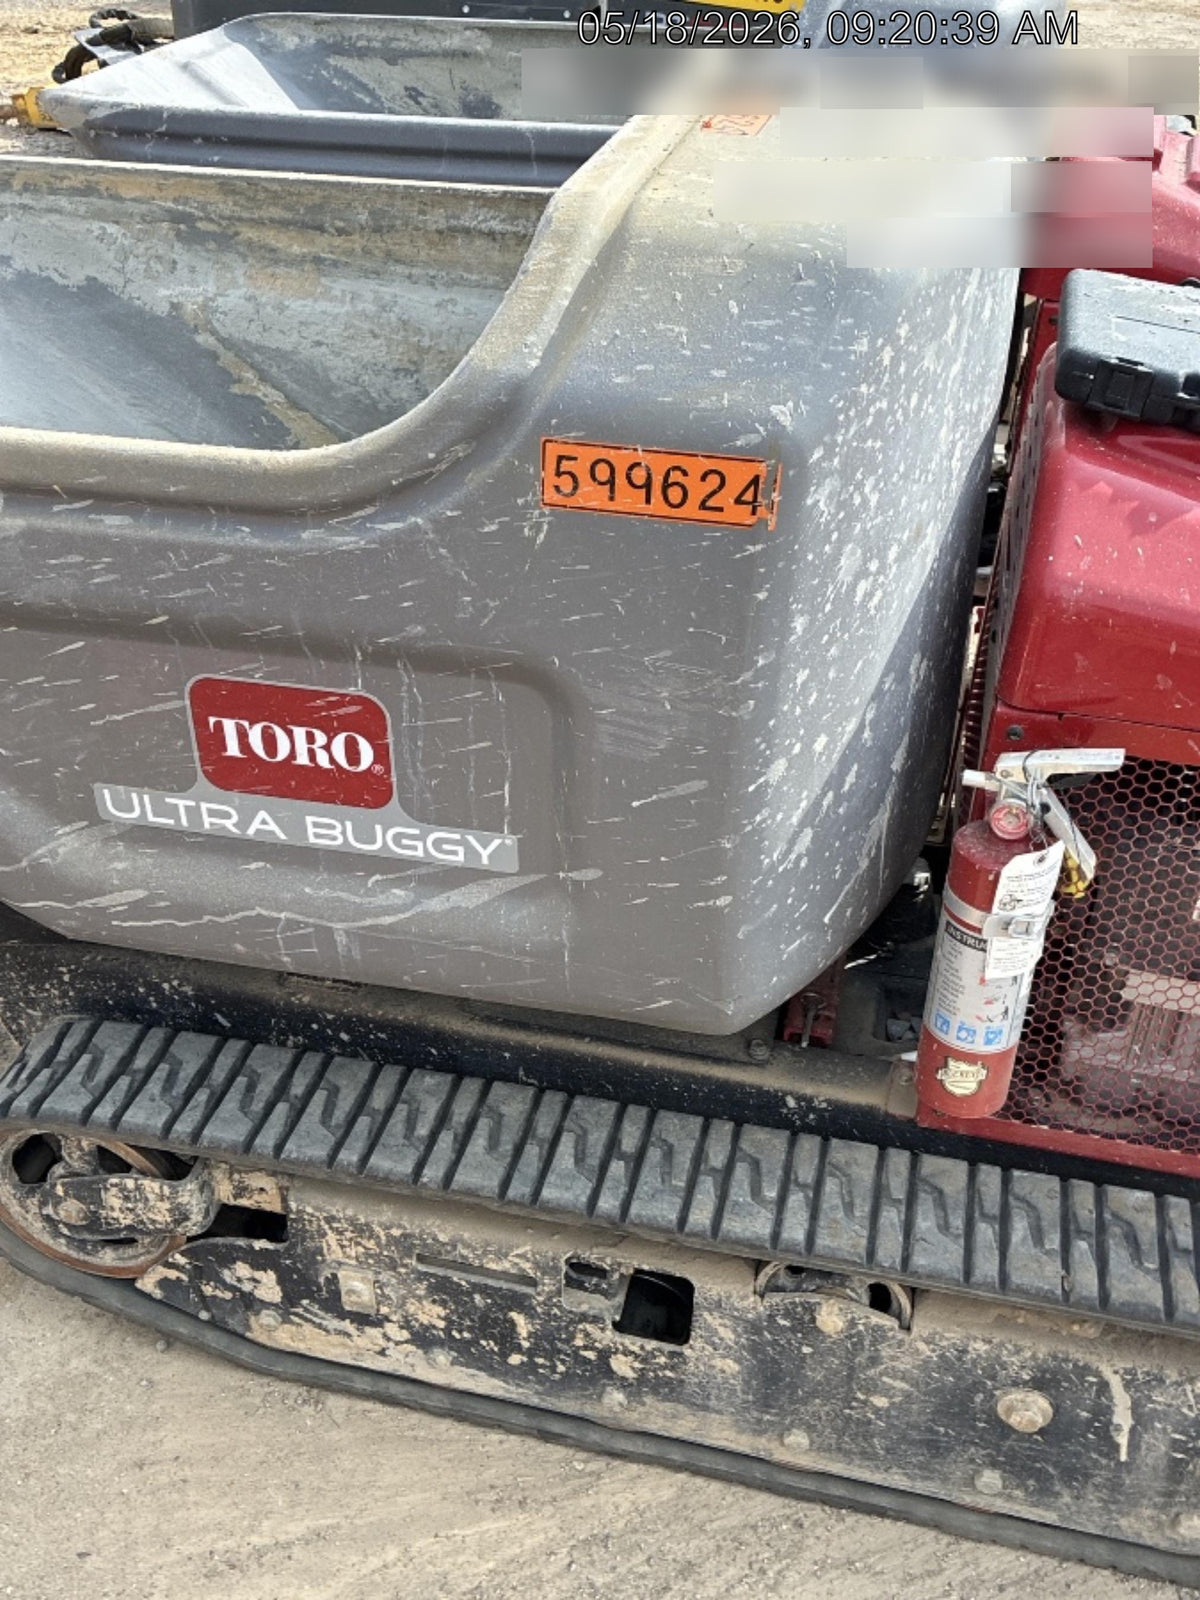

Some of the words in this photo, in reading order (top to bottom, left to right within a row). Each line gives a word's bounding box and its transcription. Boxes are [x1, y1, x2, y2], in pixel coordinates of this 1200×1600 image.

[553, 454, 764, 516] 599624
[103, 789, 288, 841] ULTRA
[305, 815, 503, 865] BUGGY
